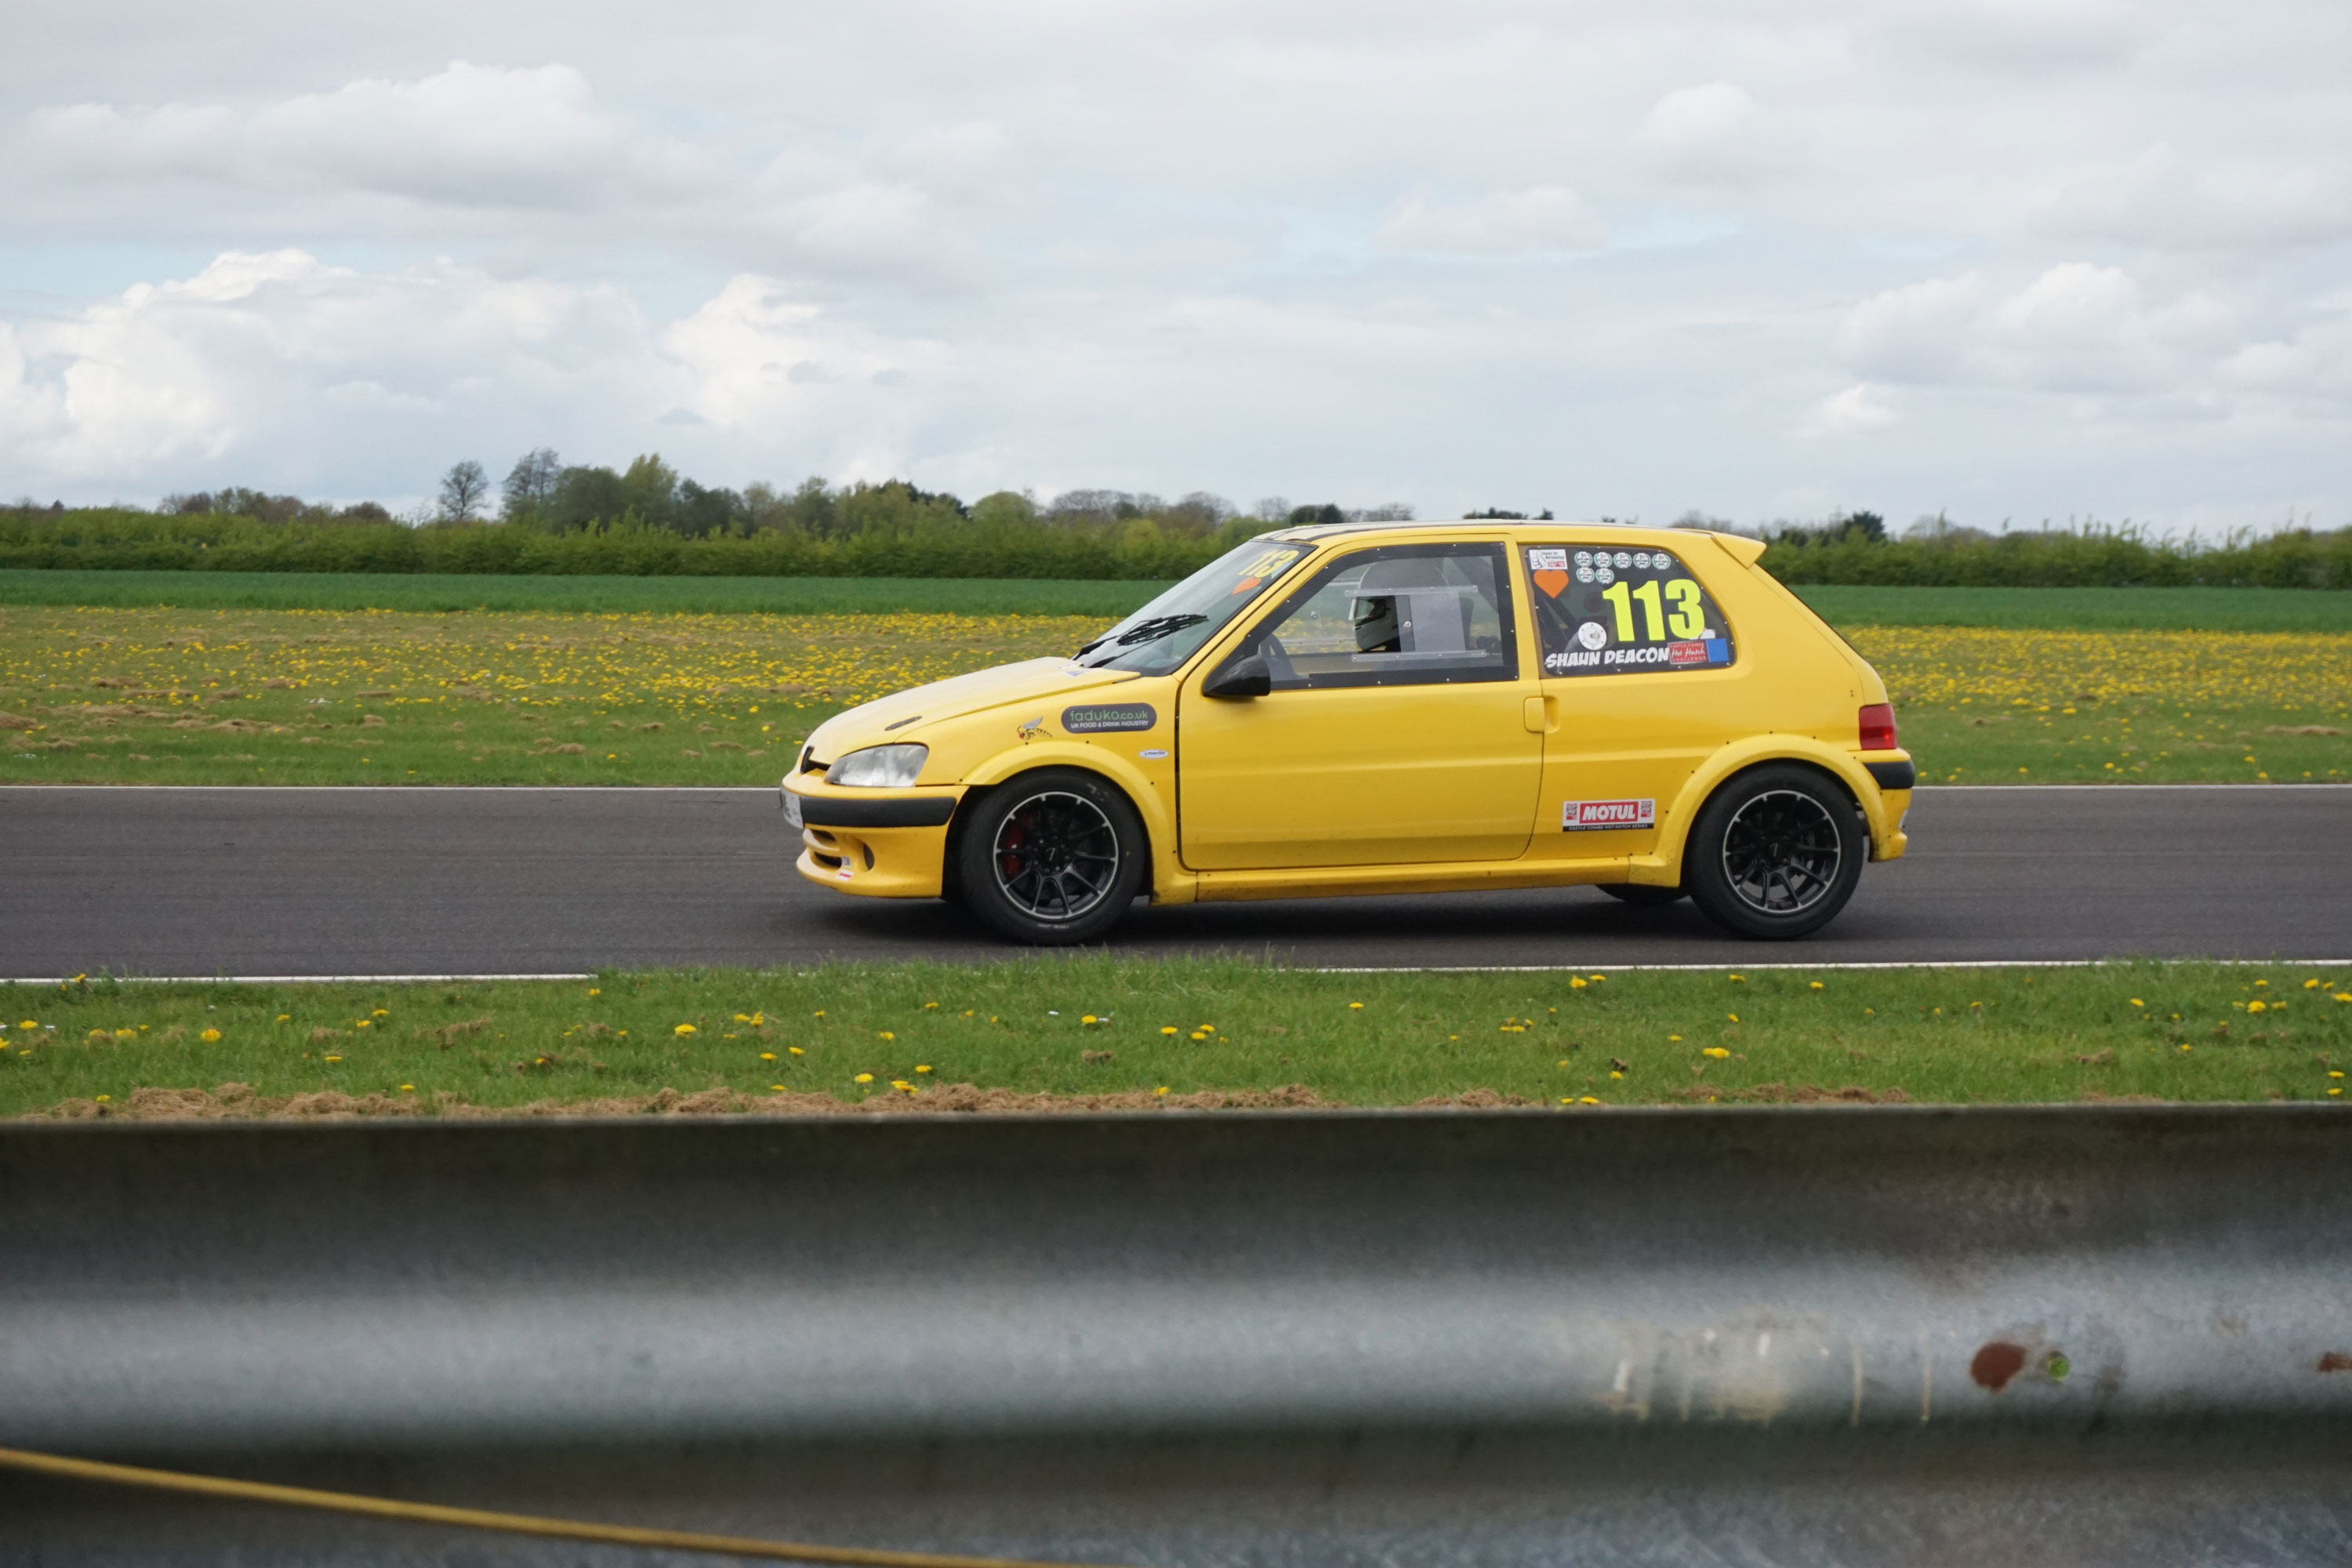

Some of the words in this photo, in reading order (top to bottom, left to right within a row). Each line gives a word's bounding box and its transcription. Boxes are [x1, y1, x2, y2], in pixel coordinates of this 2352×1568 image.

[1236, 549, 1299, 578] 113
[1602, 579, 1705, 641] 113
[1545, 652, 1601, 668] SHAUN
[1604, 647, 1669, 664] DEACON
[1685, 645, 1705, 657] Hatch
[1070, 709, 1148, 721] faduko.co.uk
[1582, 804, 1635, 821] MOTUL
